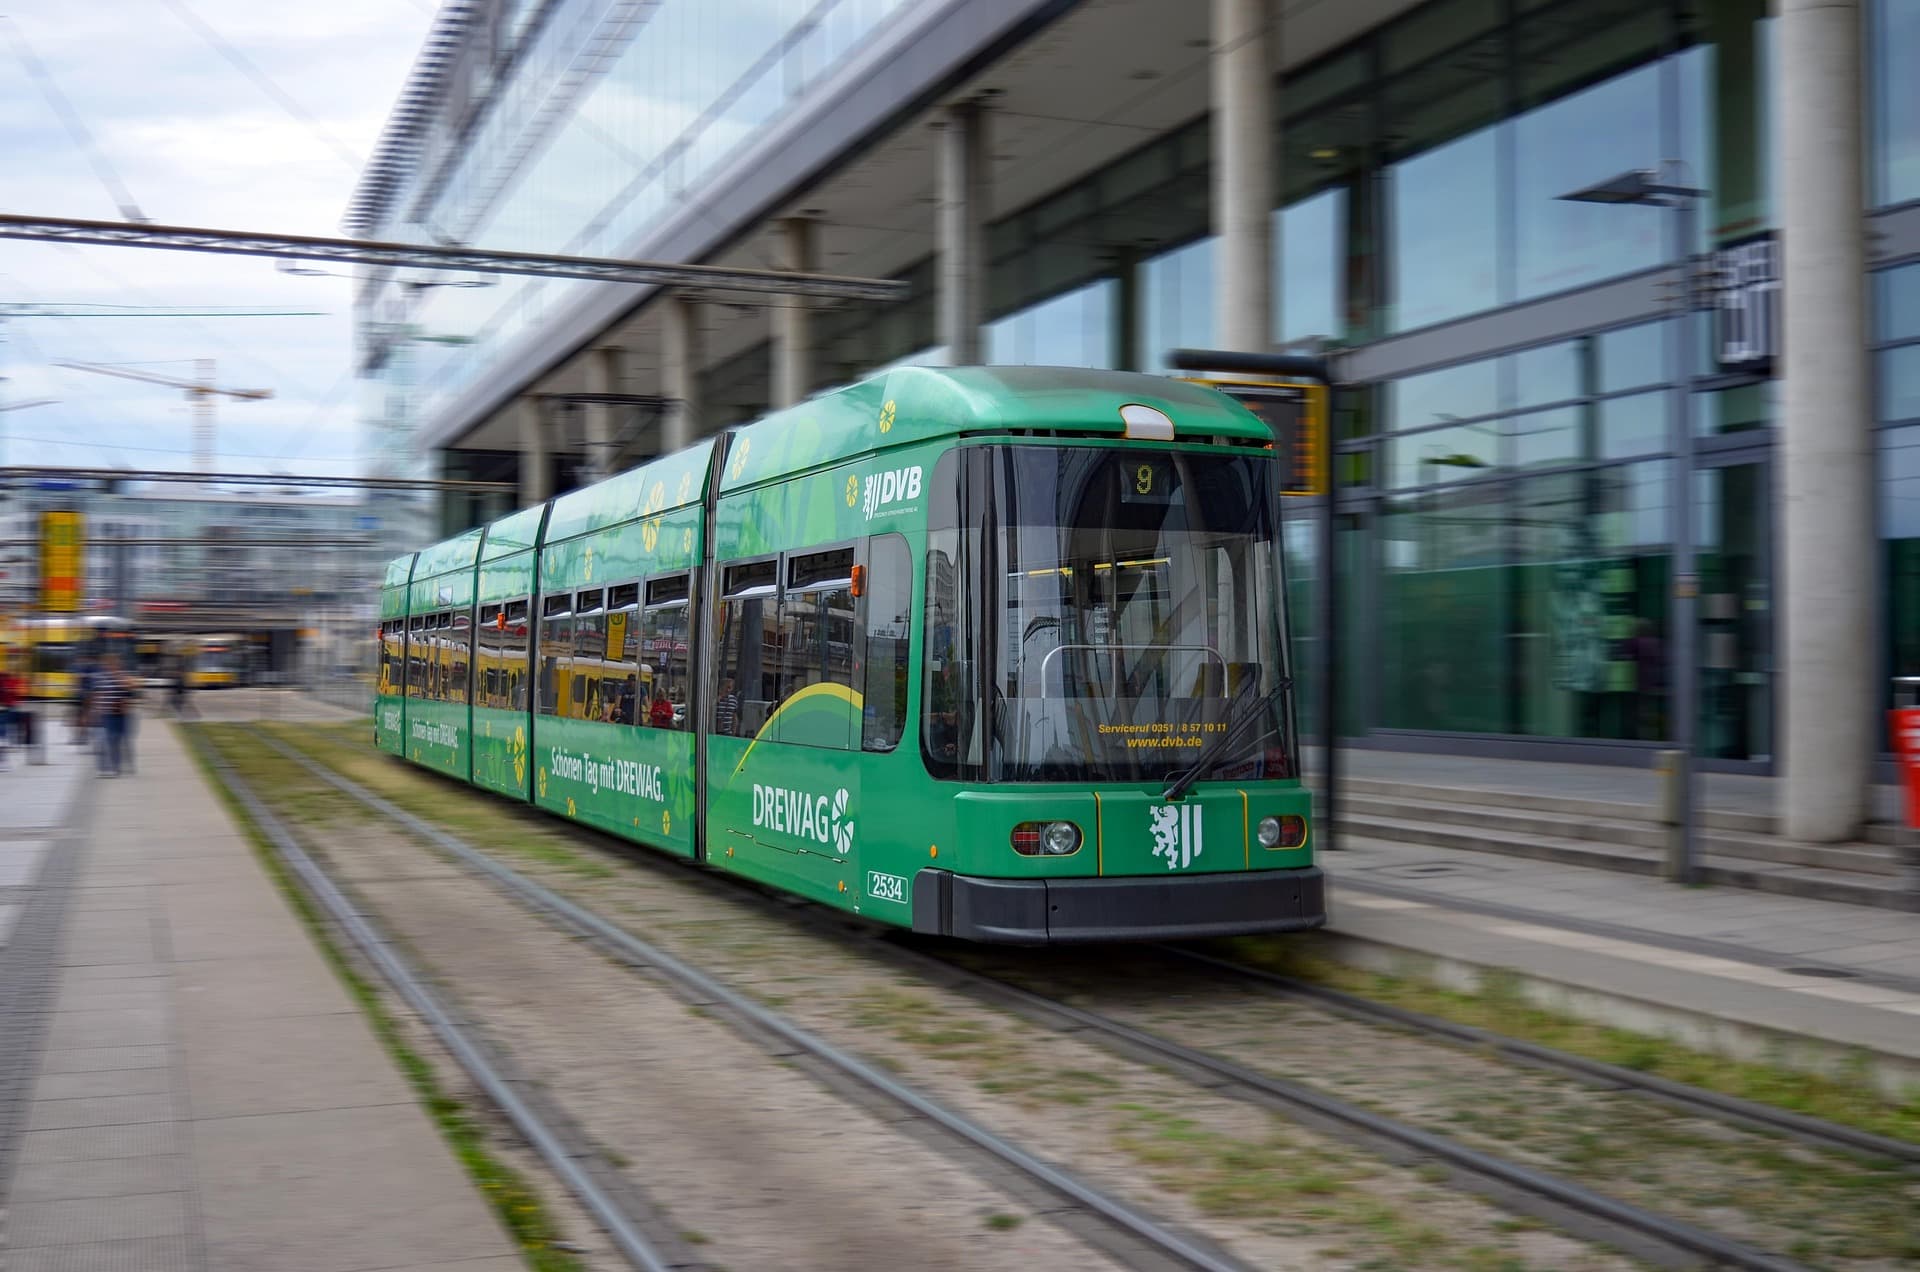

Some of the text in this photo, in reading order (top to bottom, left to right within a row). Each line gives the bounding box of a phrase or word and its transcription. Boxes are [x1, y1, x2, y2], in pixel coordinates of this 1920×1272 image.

[881, 465, 922, 504] DVB
[1137, 464, 1153, 494] 9
[1098, 724, 1149, 733] Serviceruf
[1151, 723, 1173, 732] 0351
[1181, 723, 1187, 732] 8
[1190, 723, 1201, 732] 57
[1204, 723, 1214, 732] 10
[1216, 723, 1226, 732] 11
[1127, 735, 1202, 748] www.dvb.de
[551, 746, 664, 802] Schönen Tag mit DREWAG.
[753, 784, 829, 843] DREWAG
[873, 874, 902, 900] 2534
